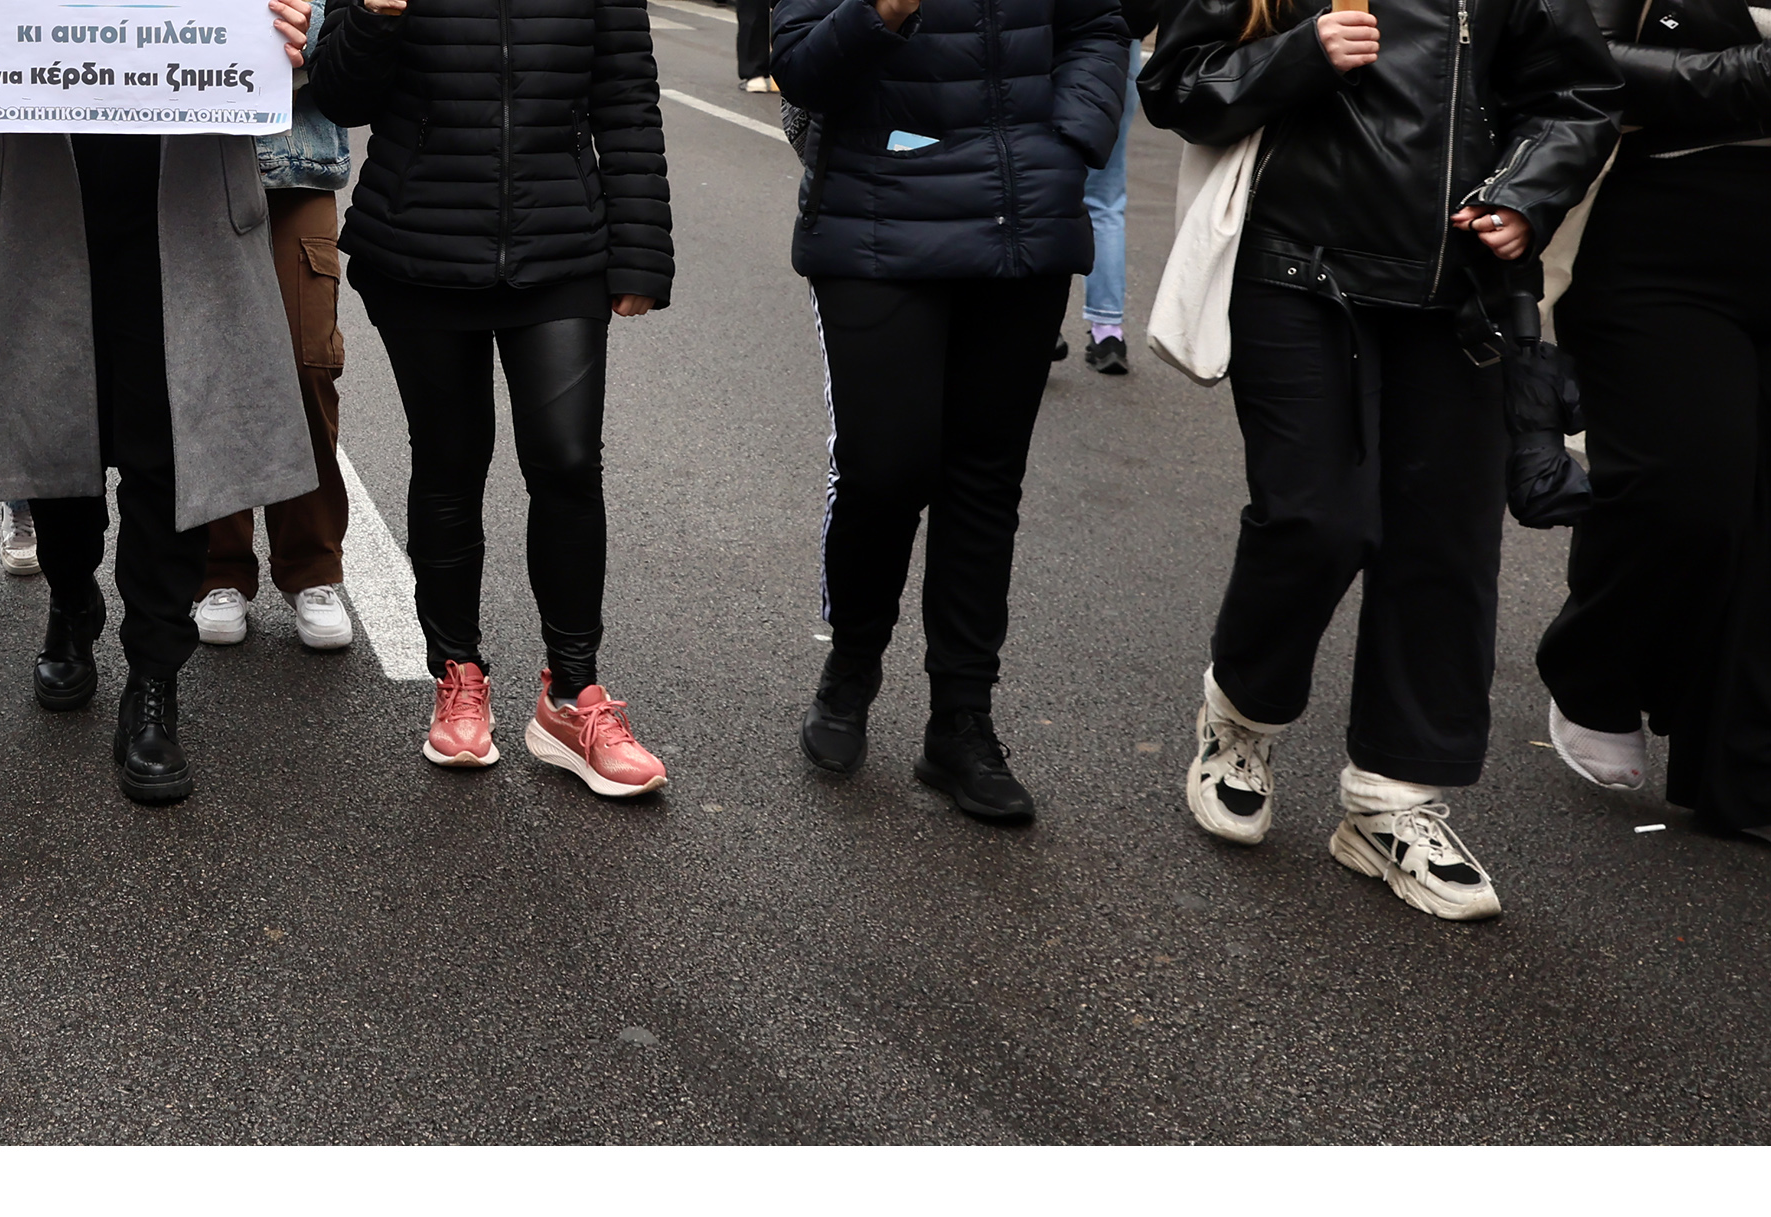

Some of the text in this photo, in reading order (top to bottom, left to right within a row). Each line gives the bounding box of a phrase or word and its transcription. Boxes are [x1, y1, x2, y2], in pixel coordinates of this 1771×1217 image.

[18, 19, 227, 48] κι αυτοί μιλάνε
[31, 61, 114, 89] κέρδη
[124, 71, 158, 86] και
[166, 63, 255, 92] ζημιές
[95, 107, 180, 122] ΣΥΛΛΟΓΟΙ
[185, 108, 258, 123] ΑΘΗΝΑΣ
